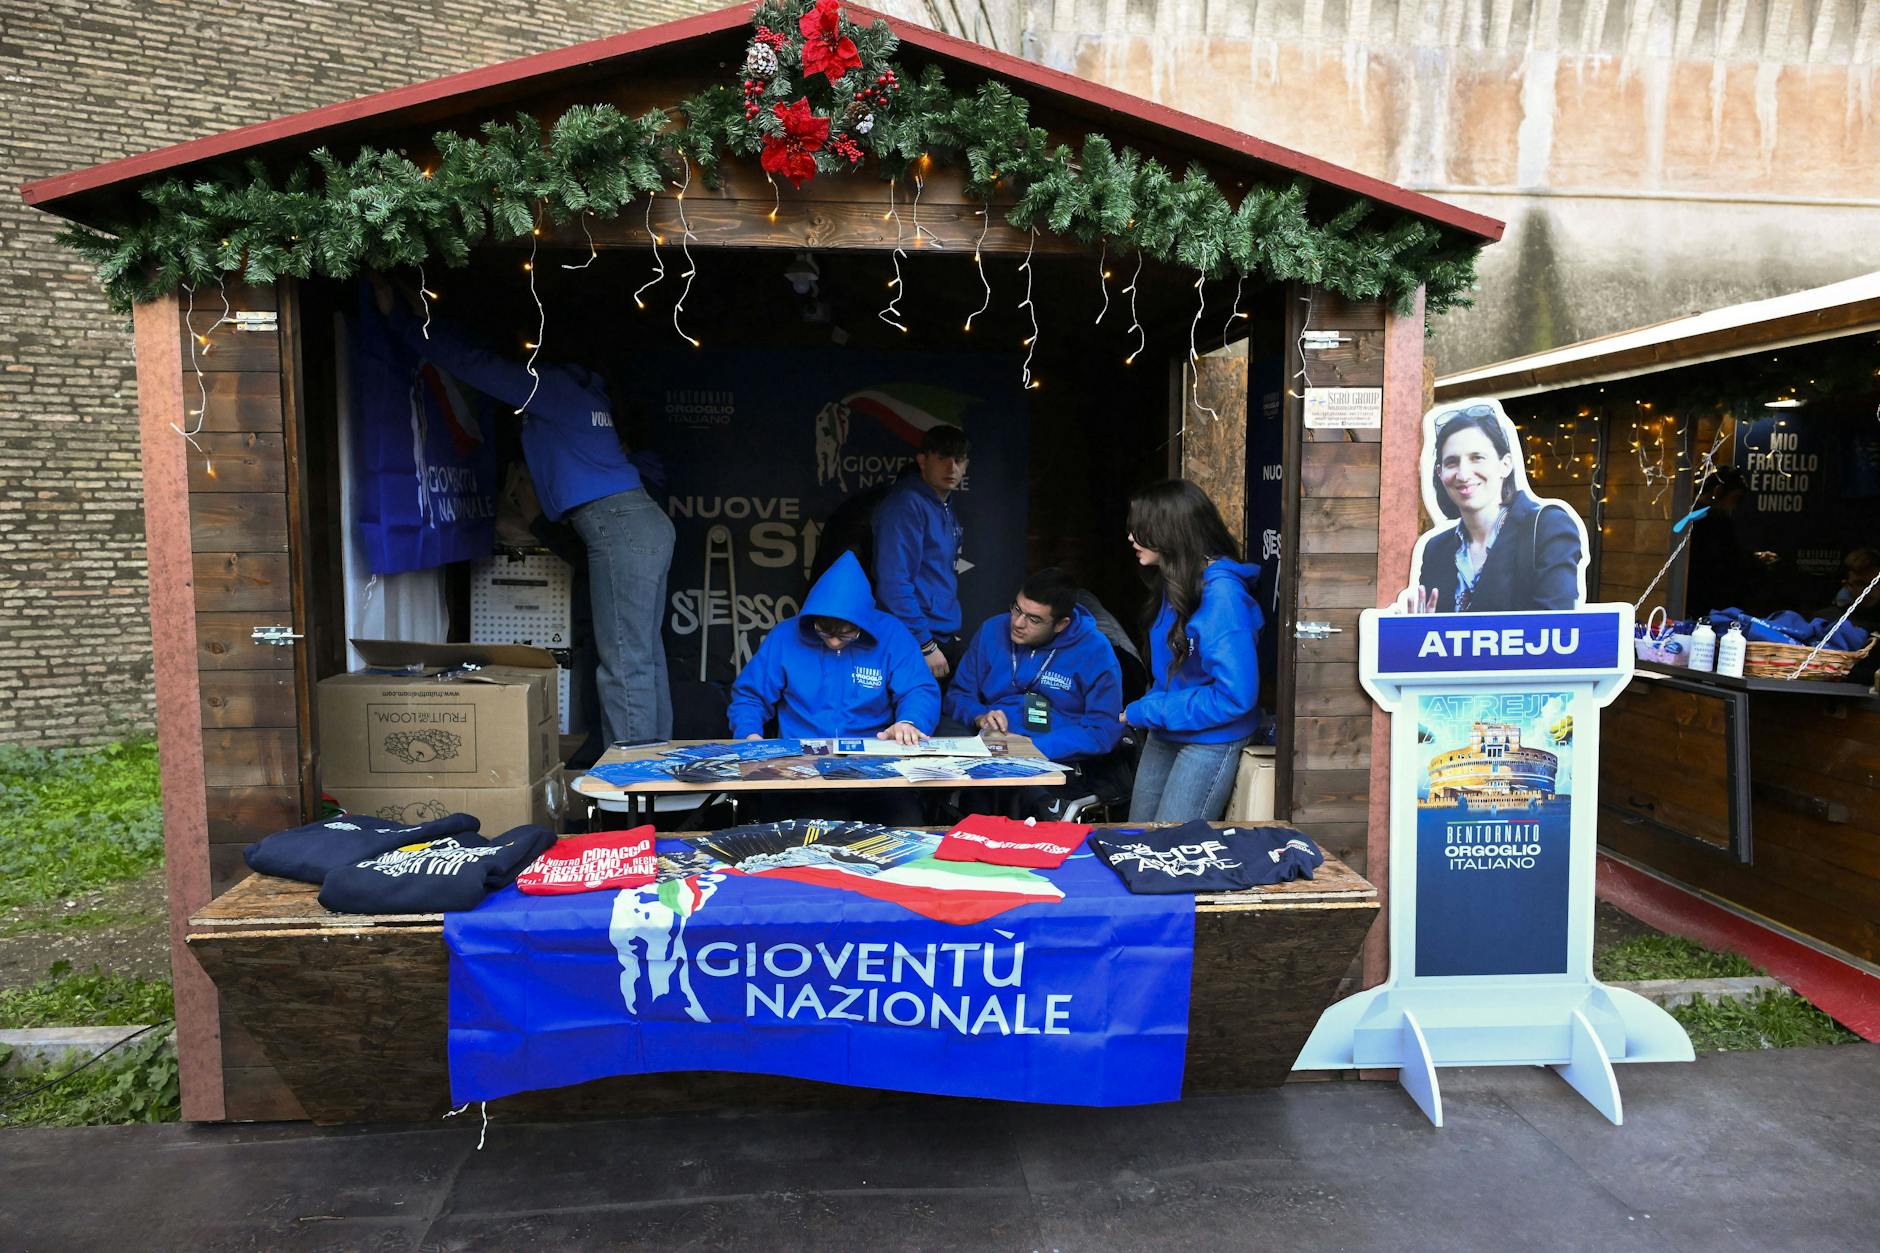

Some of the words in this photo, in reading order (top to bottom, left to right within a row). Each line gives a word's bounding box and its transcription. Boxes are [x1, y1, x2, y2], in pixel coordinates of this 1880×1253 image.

[1770, 433, 1799, 451] MIO
[1747, 453, 1818, 472] FRATELLO
[1751, 470, 1759, 491] È
[1762, 474, 1809, 492] FIGLIO
[668, 496, 800, 519] NUOVE
[1757, 495, 1803, 512] UNICO
[671, 589, 799, 635] STESSO
[1418, 628, 1580, 657] ATREJU
[430, 712, 467, 723] FRUIT
[1426, 694, 1568, 721] ATREJU
[1446, 824, 1540, 844] BENTORNATO
[546, 858, 580, 867] NOSTRO
[582, 840, 650, 862] CORAGGIO
[1445, 844, 1541, 857] ORGOGLIO
[1450, 857, 1535, 870] ITALIANO
[696, 928, 1025, 988] GIOVENTÙ
[746, 982, 1073, 1036] NAZIONALE
